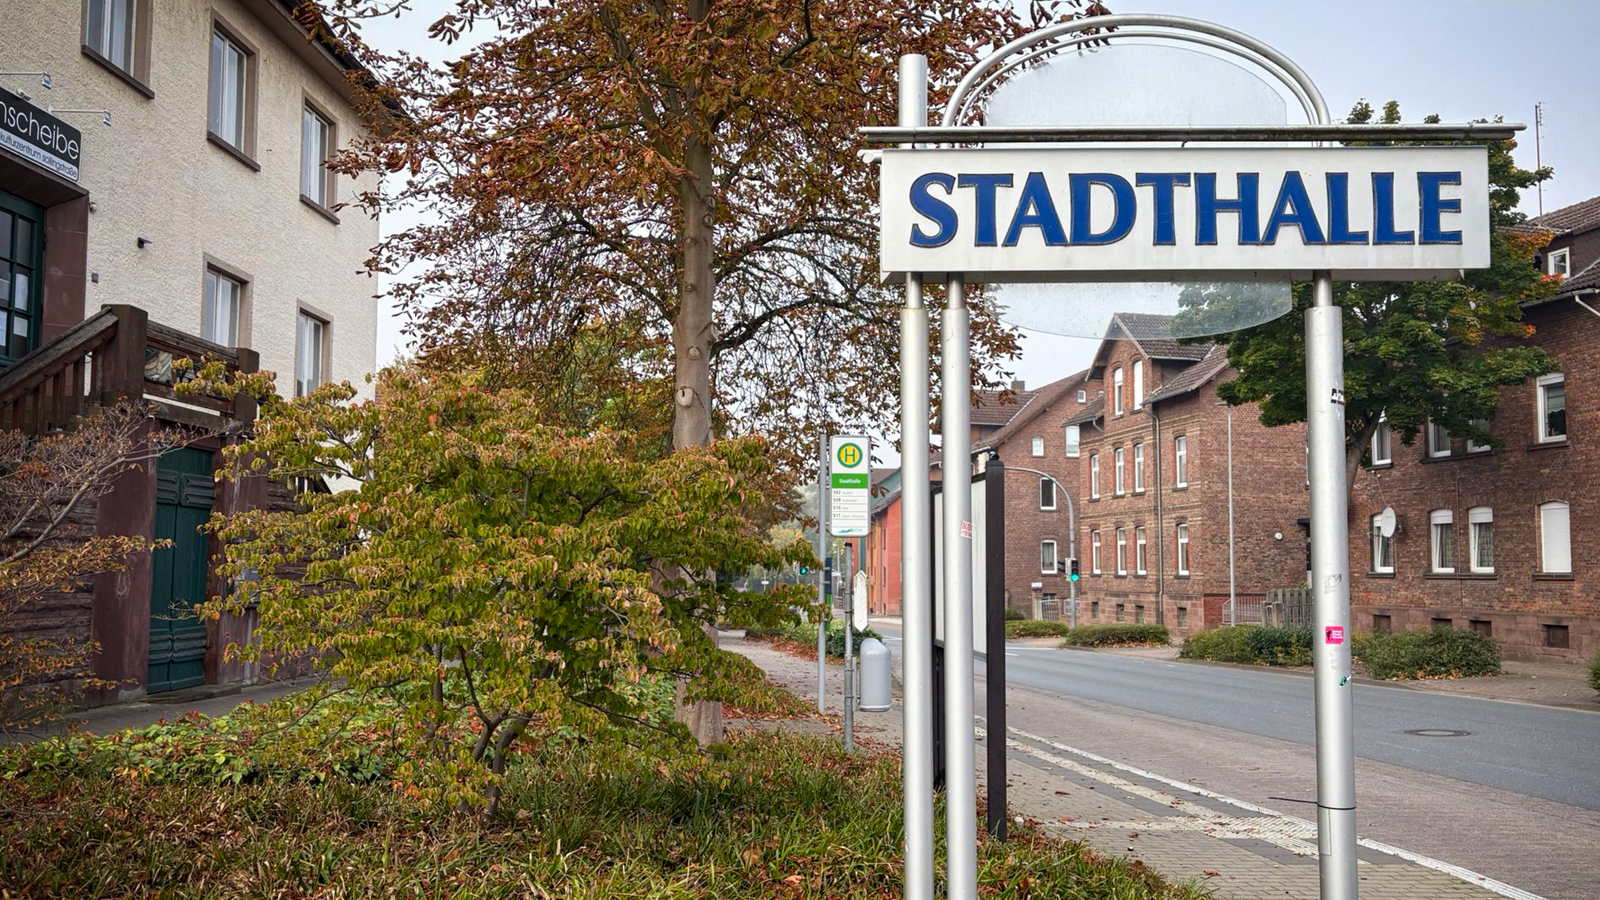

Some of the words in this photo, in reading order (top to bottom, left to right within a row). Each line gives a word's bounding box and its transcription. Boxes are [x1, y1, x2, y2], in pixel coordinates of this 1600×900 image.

[0, 130, 41, 160] kulturzentrum
[42, 154, 77, 178] sollingstraße
[909, 171, 1463, 248] STADTHALLE
[844, 448, 856, 463] H
